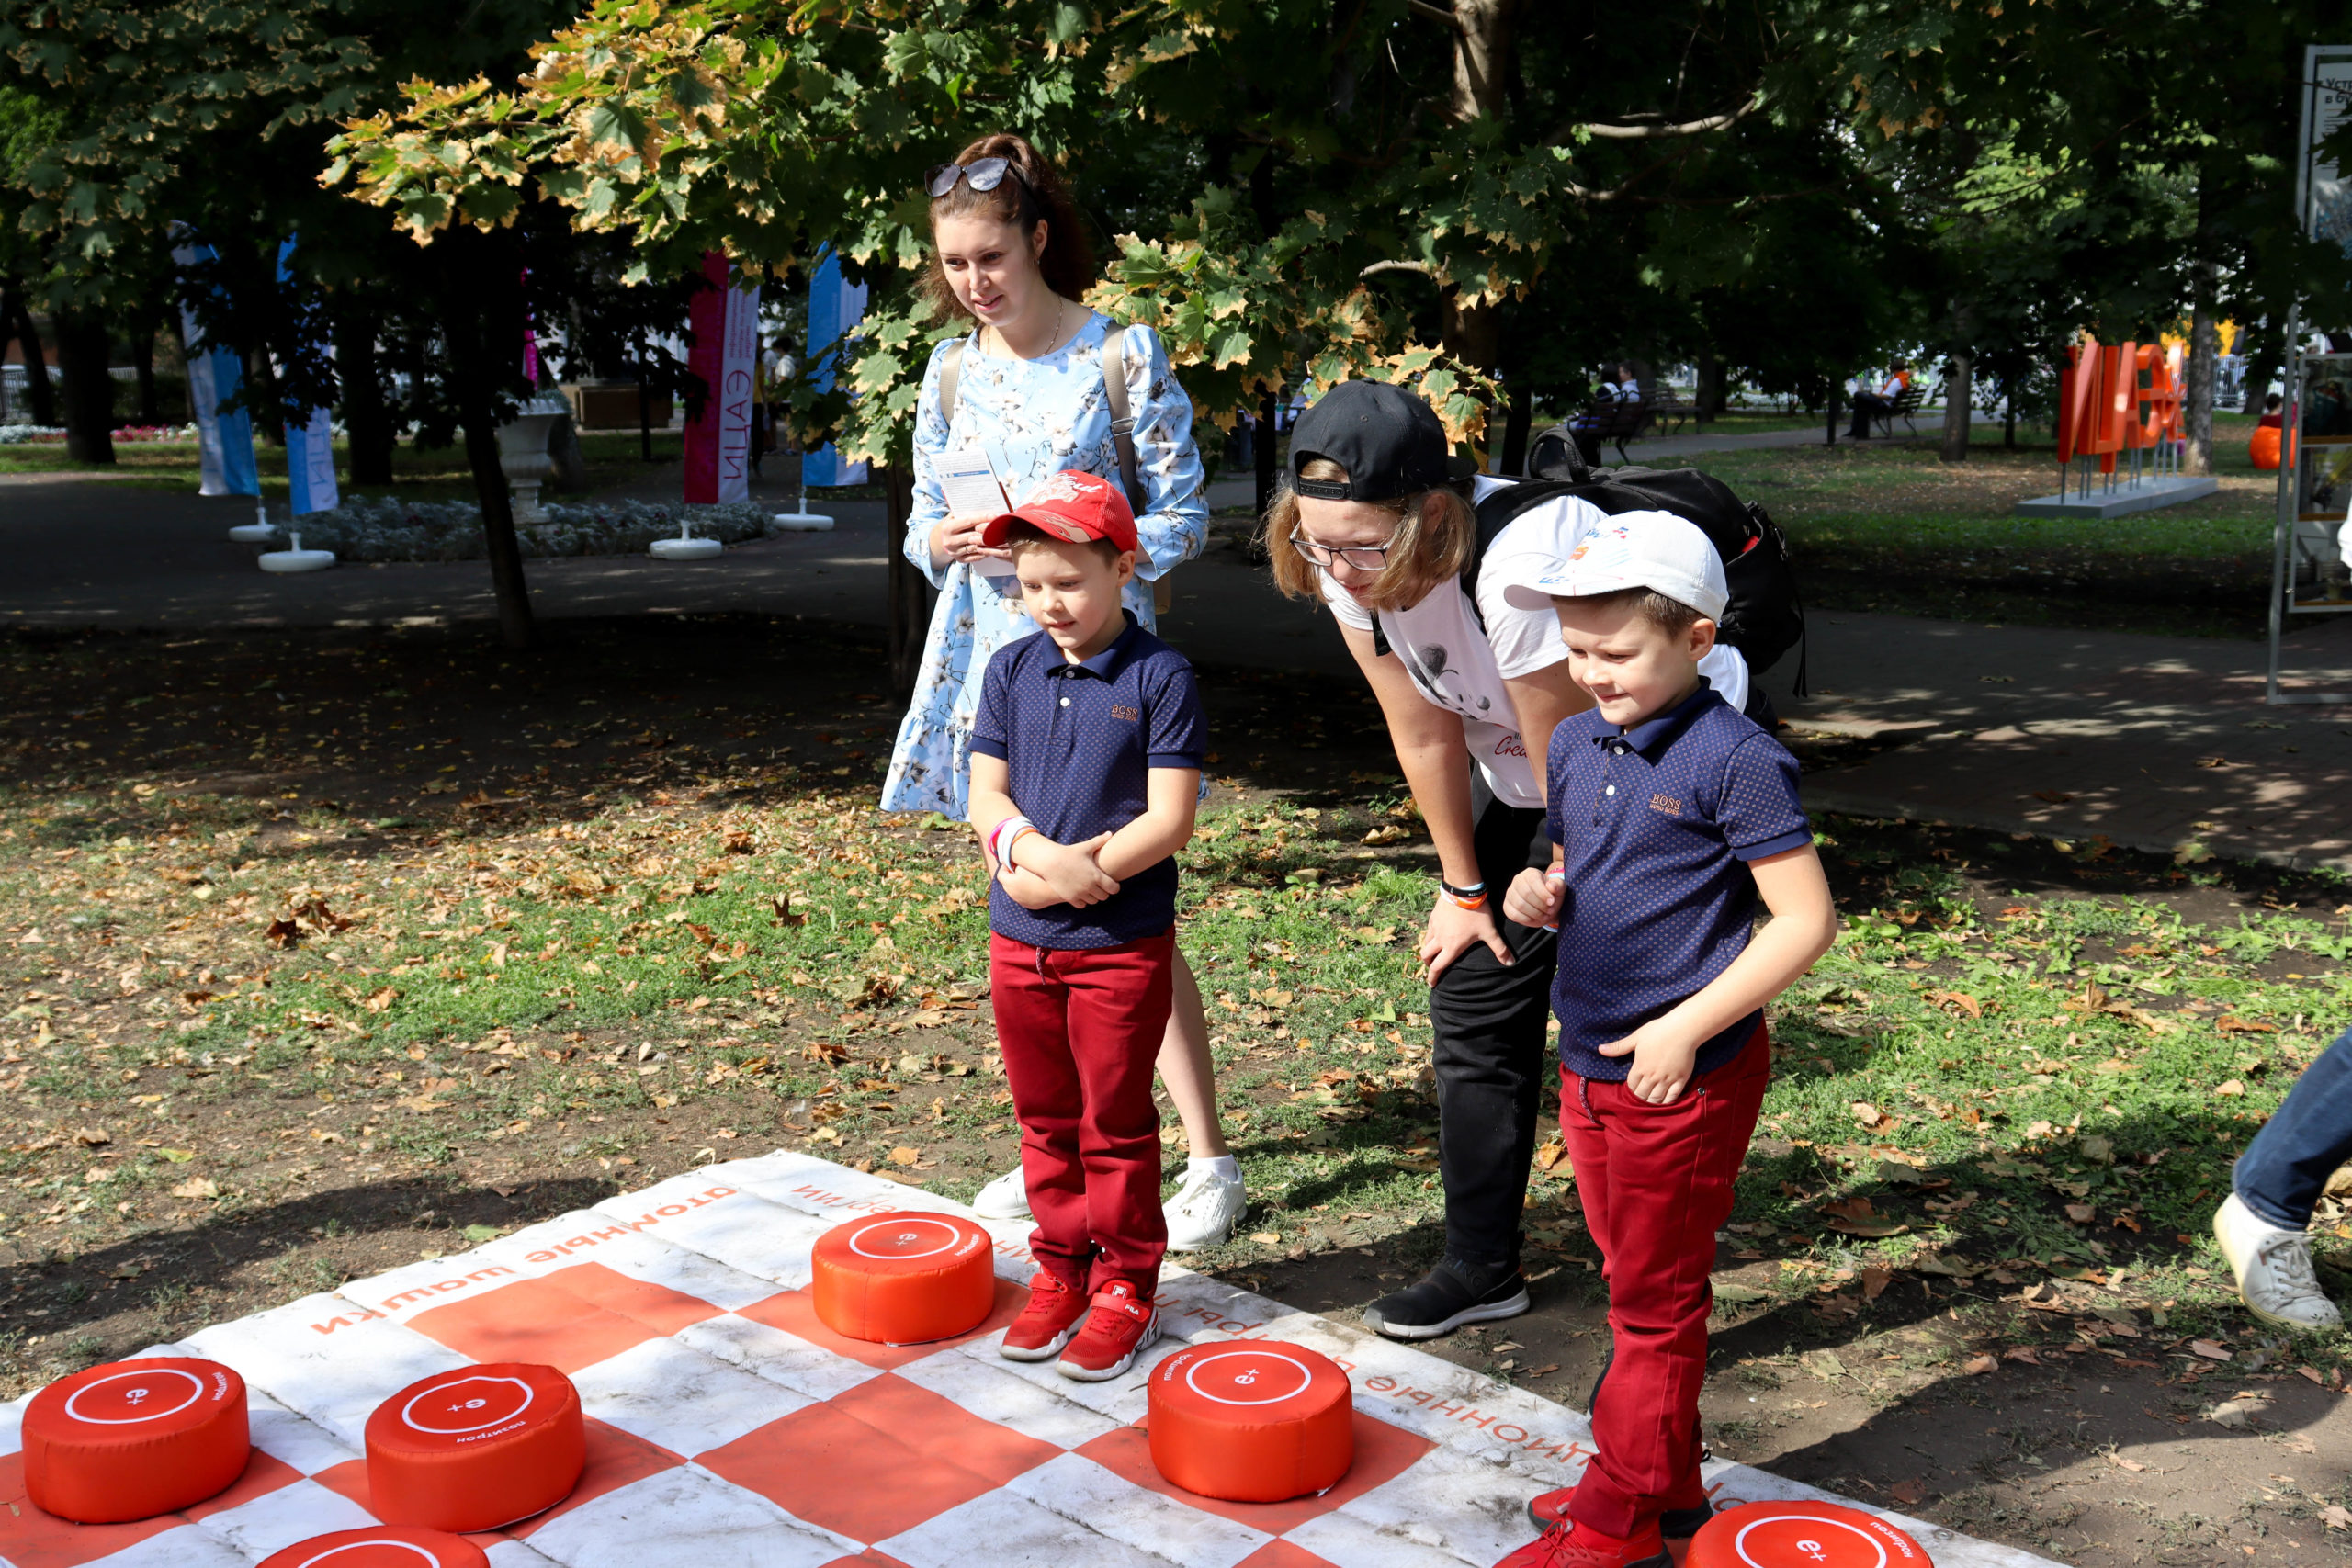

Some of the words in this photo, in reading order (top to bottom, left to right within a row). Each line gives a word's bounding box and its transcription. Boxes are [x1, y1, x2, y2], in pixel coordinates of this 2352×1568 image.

[723, 370, 752, 479] ИЦАЭ
[1111, 705, 1138, 717] BOSS
[1494, 735, 1528, 758] Crea
[1651, 793, 1682, 810] BOSS
[524, 1187, 738, 1265] атомные
[310, 1267, 516, 1337] шашки
[1125, 1303, 1140, 1315] FILA
[456, 1420, 526, 1444] позитрон
[1870, 1520, 1914, 1559] позитрон
